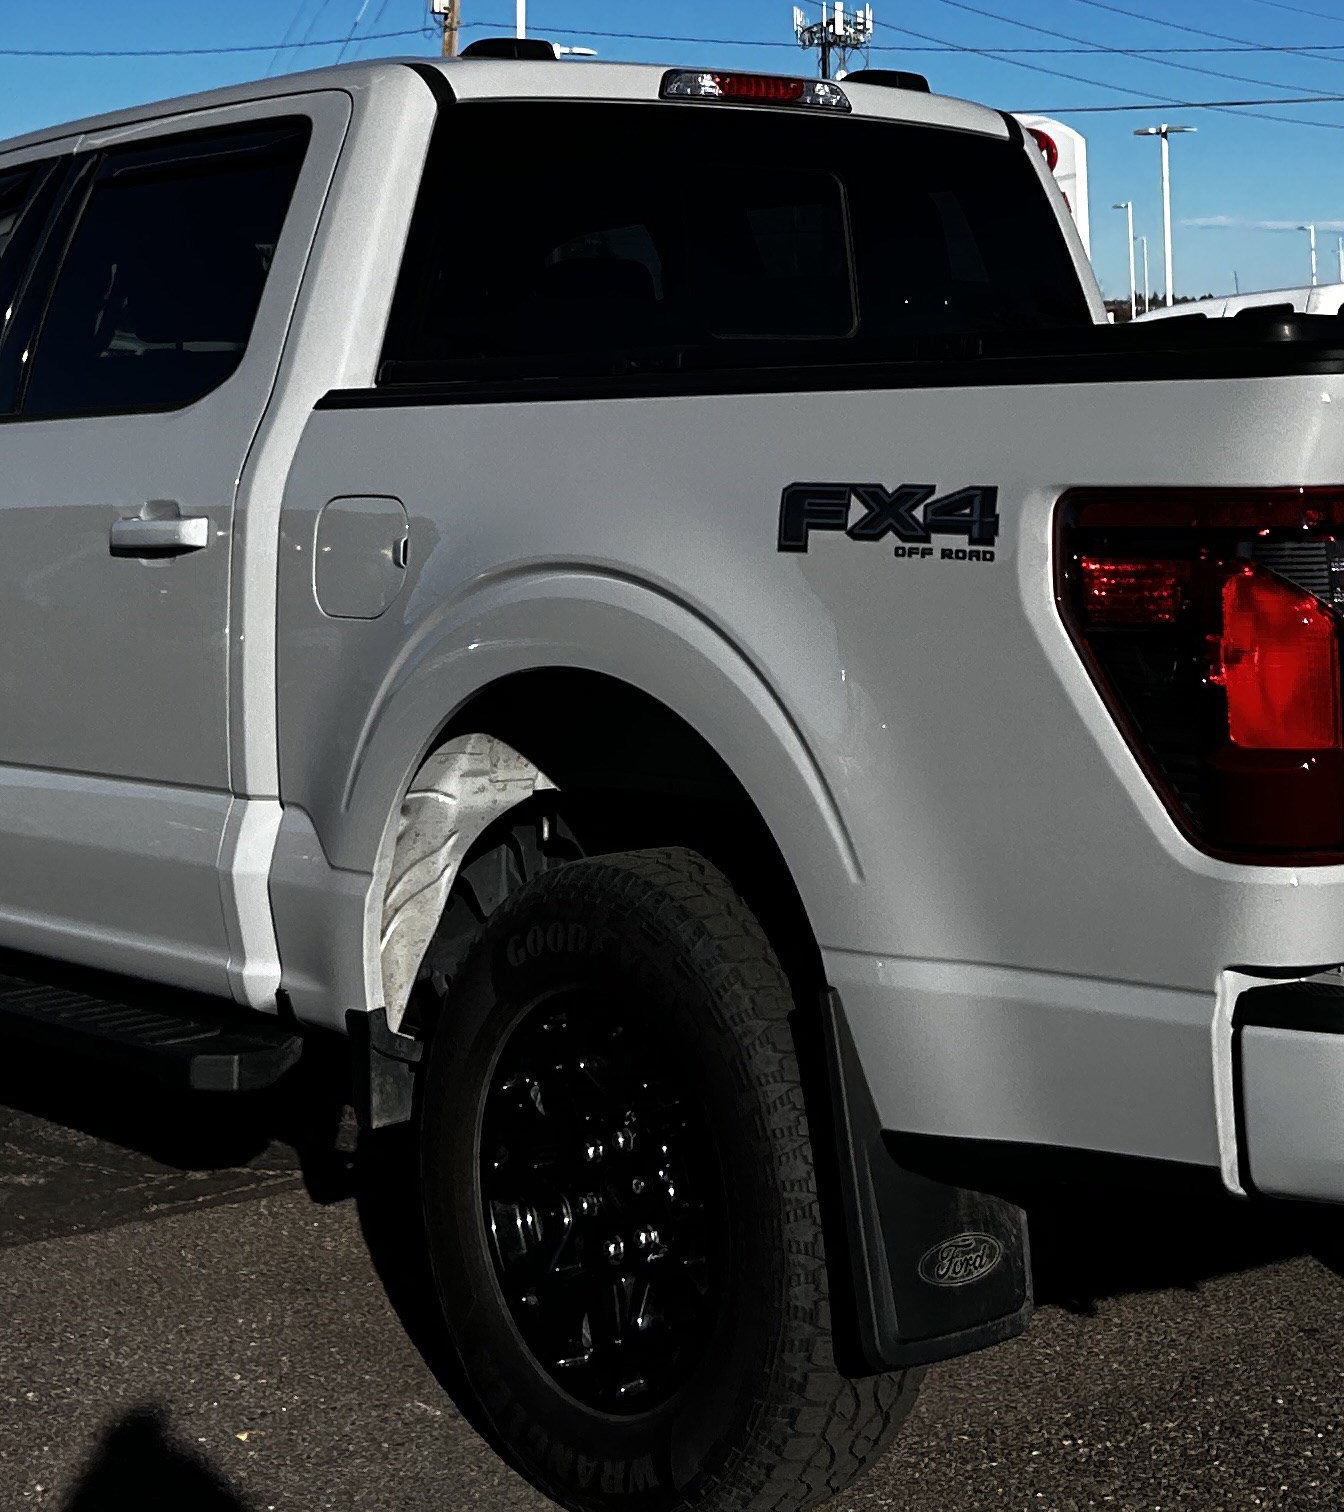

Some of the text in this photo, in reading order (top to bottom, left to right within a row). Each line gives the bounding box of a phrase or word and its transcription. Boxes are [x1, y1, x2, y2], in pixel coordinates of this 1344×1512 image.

[777, 482, 1000, 553] FX4
[894, 546, 995, 562] OFF ROAD
[935, 1238, 990, 1281] Ford
